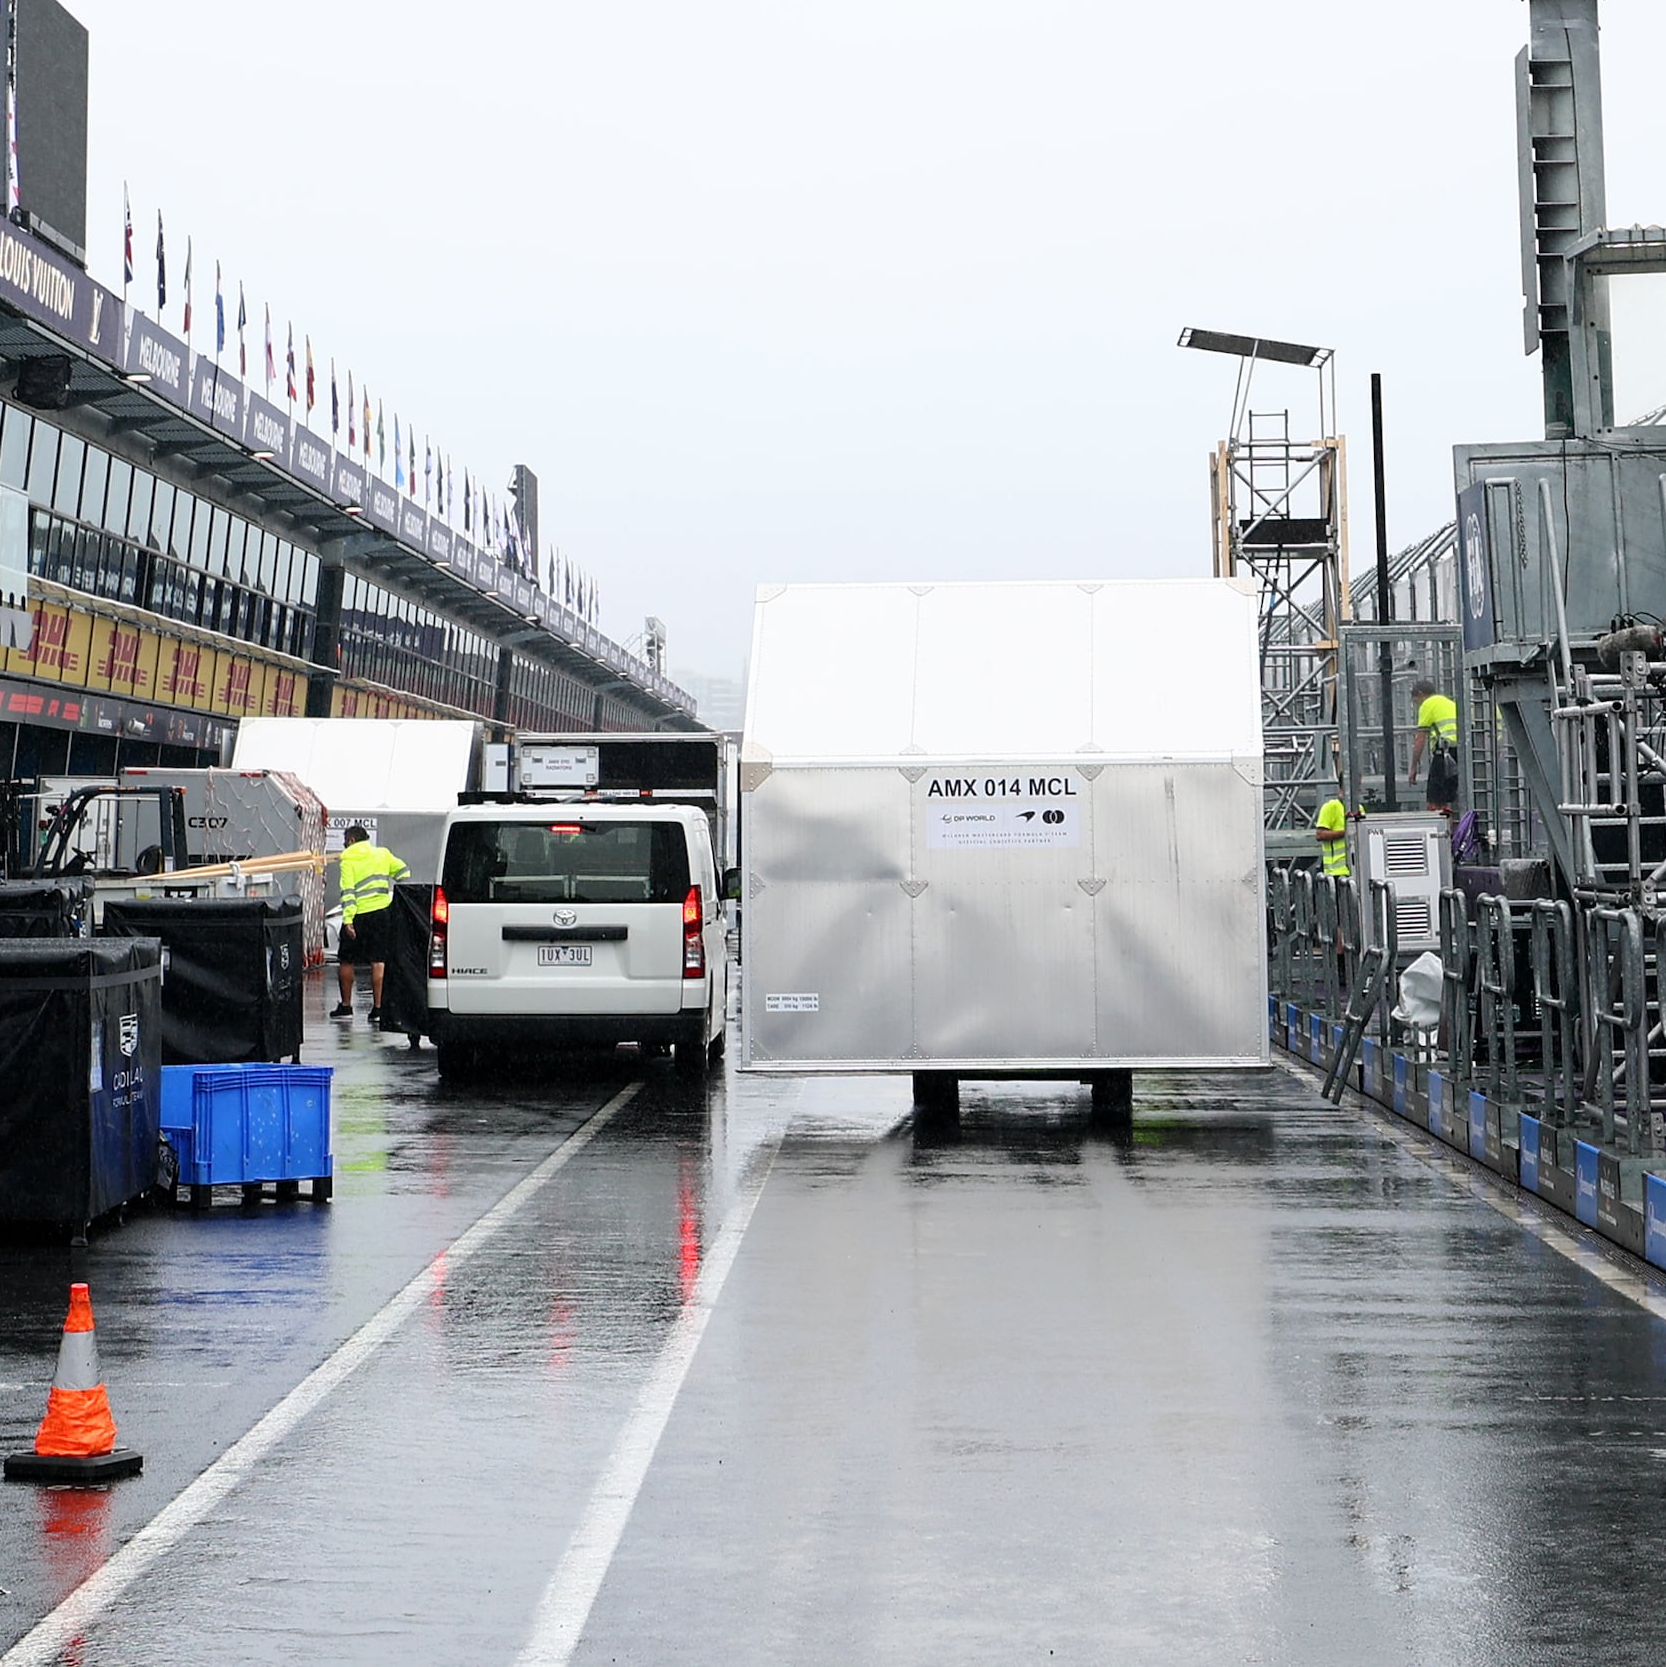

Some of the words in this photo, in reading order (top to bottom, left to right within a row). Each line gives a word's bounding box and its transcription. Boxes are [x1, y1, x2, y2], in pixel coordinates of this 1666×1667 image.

[31, 254, 74, 320] VUITTON
[139, 333, 181, 388] MELBOURNE
[928, 779, 977, 797] AMX
[985, 778, 1021, 797] 014
[1029, 778, 1077, 796] MCL
[334, 818, 351, 828] 007
[354, 818, 377, 828] MCL
[966, 814, 995, 822] WORLD
[541, 949, 561, 961] 1UX
[570, 949, 589, 961] 3UL
